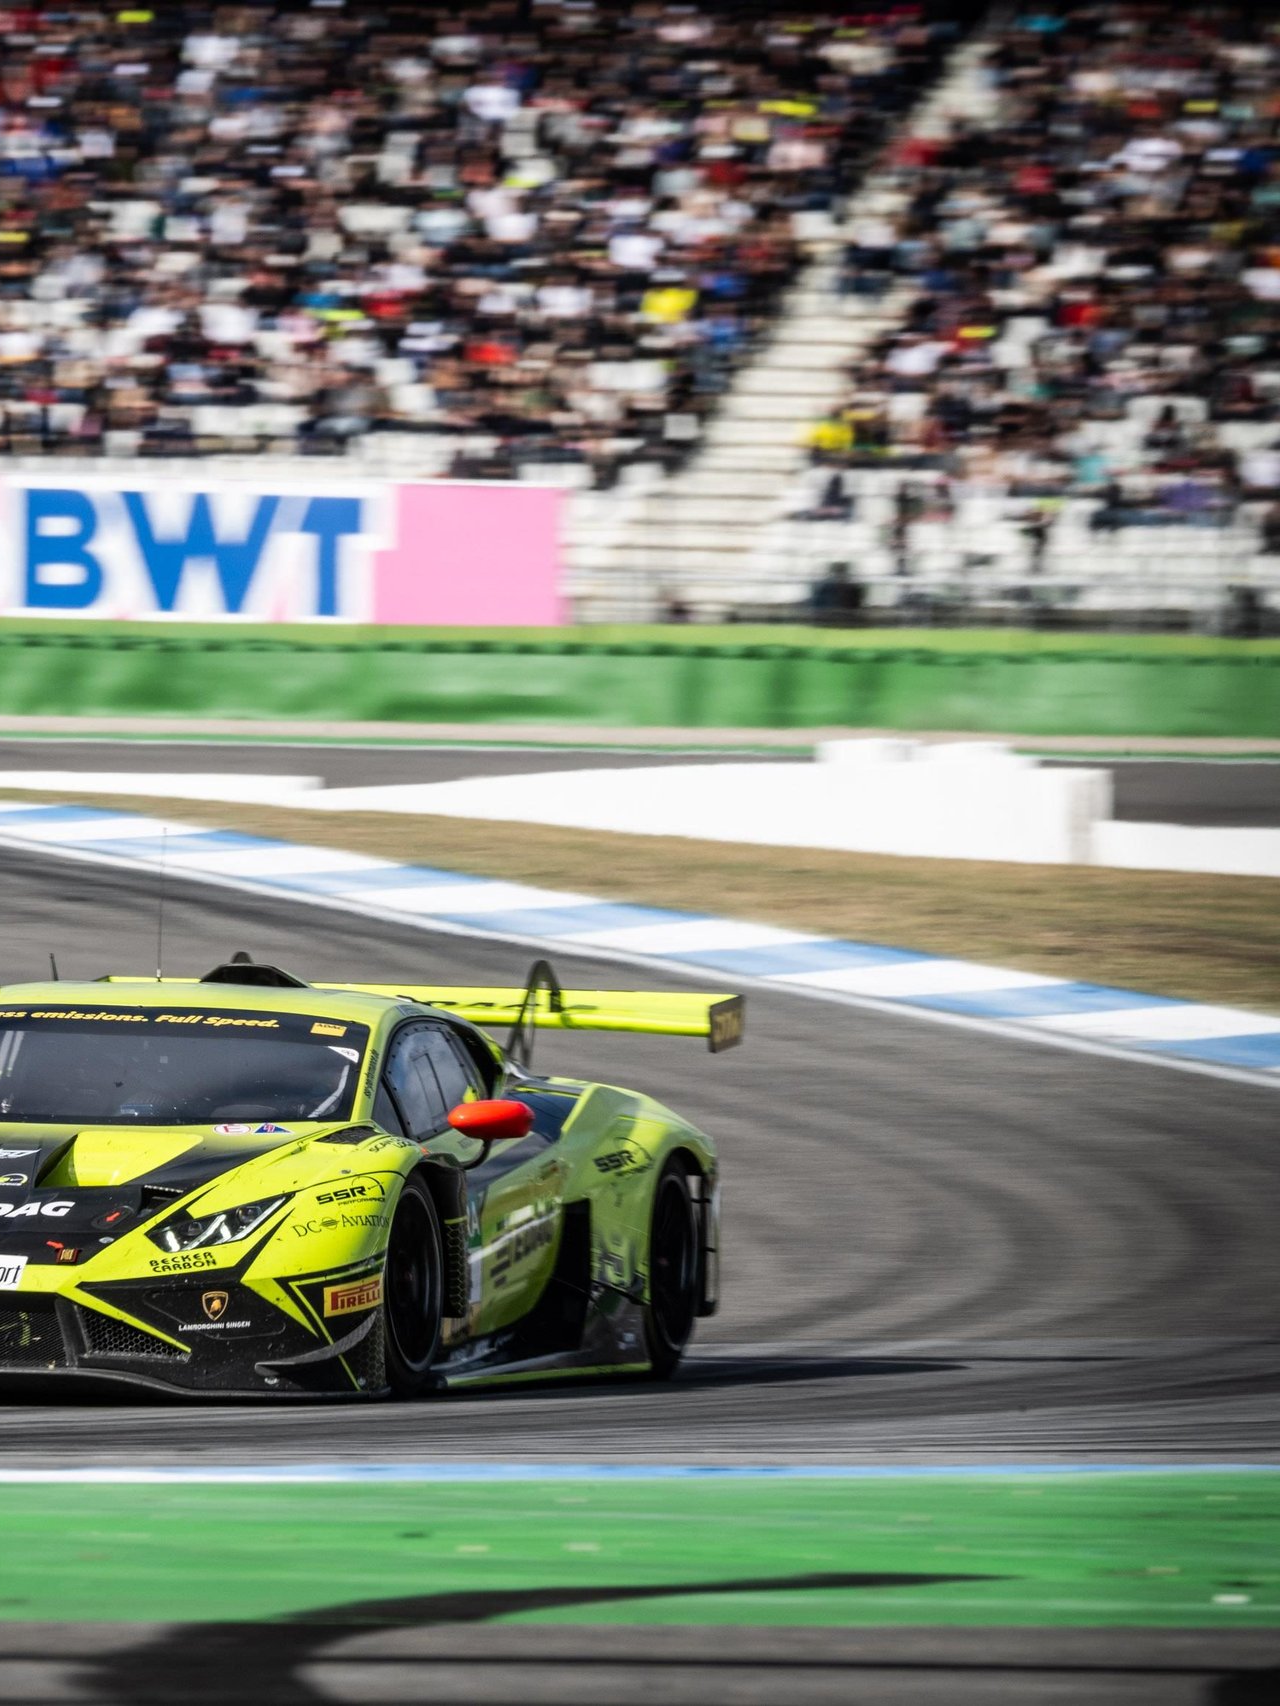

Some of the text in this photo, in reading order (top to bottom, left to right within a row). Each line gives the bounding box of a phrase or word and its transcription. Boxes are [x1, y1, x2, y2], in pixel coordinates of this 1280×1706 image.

[24, 488, 362, 616] BWT
[31, 1010, 149, 1022] emissions.
[154, 1014, 203, 1024] Full
[202, 1016, 280, 1028] Speed.
[315, 1186, 367, 1205] SSR
[149, 1251, 213, 1267] BECKER
[152, 1258, 217, 1273] CARBON
